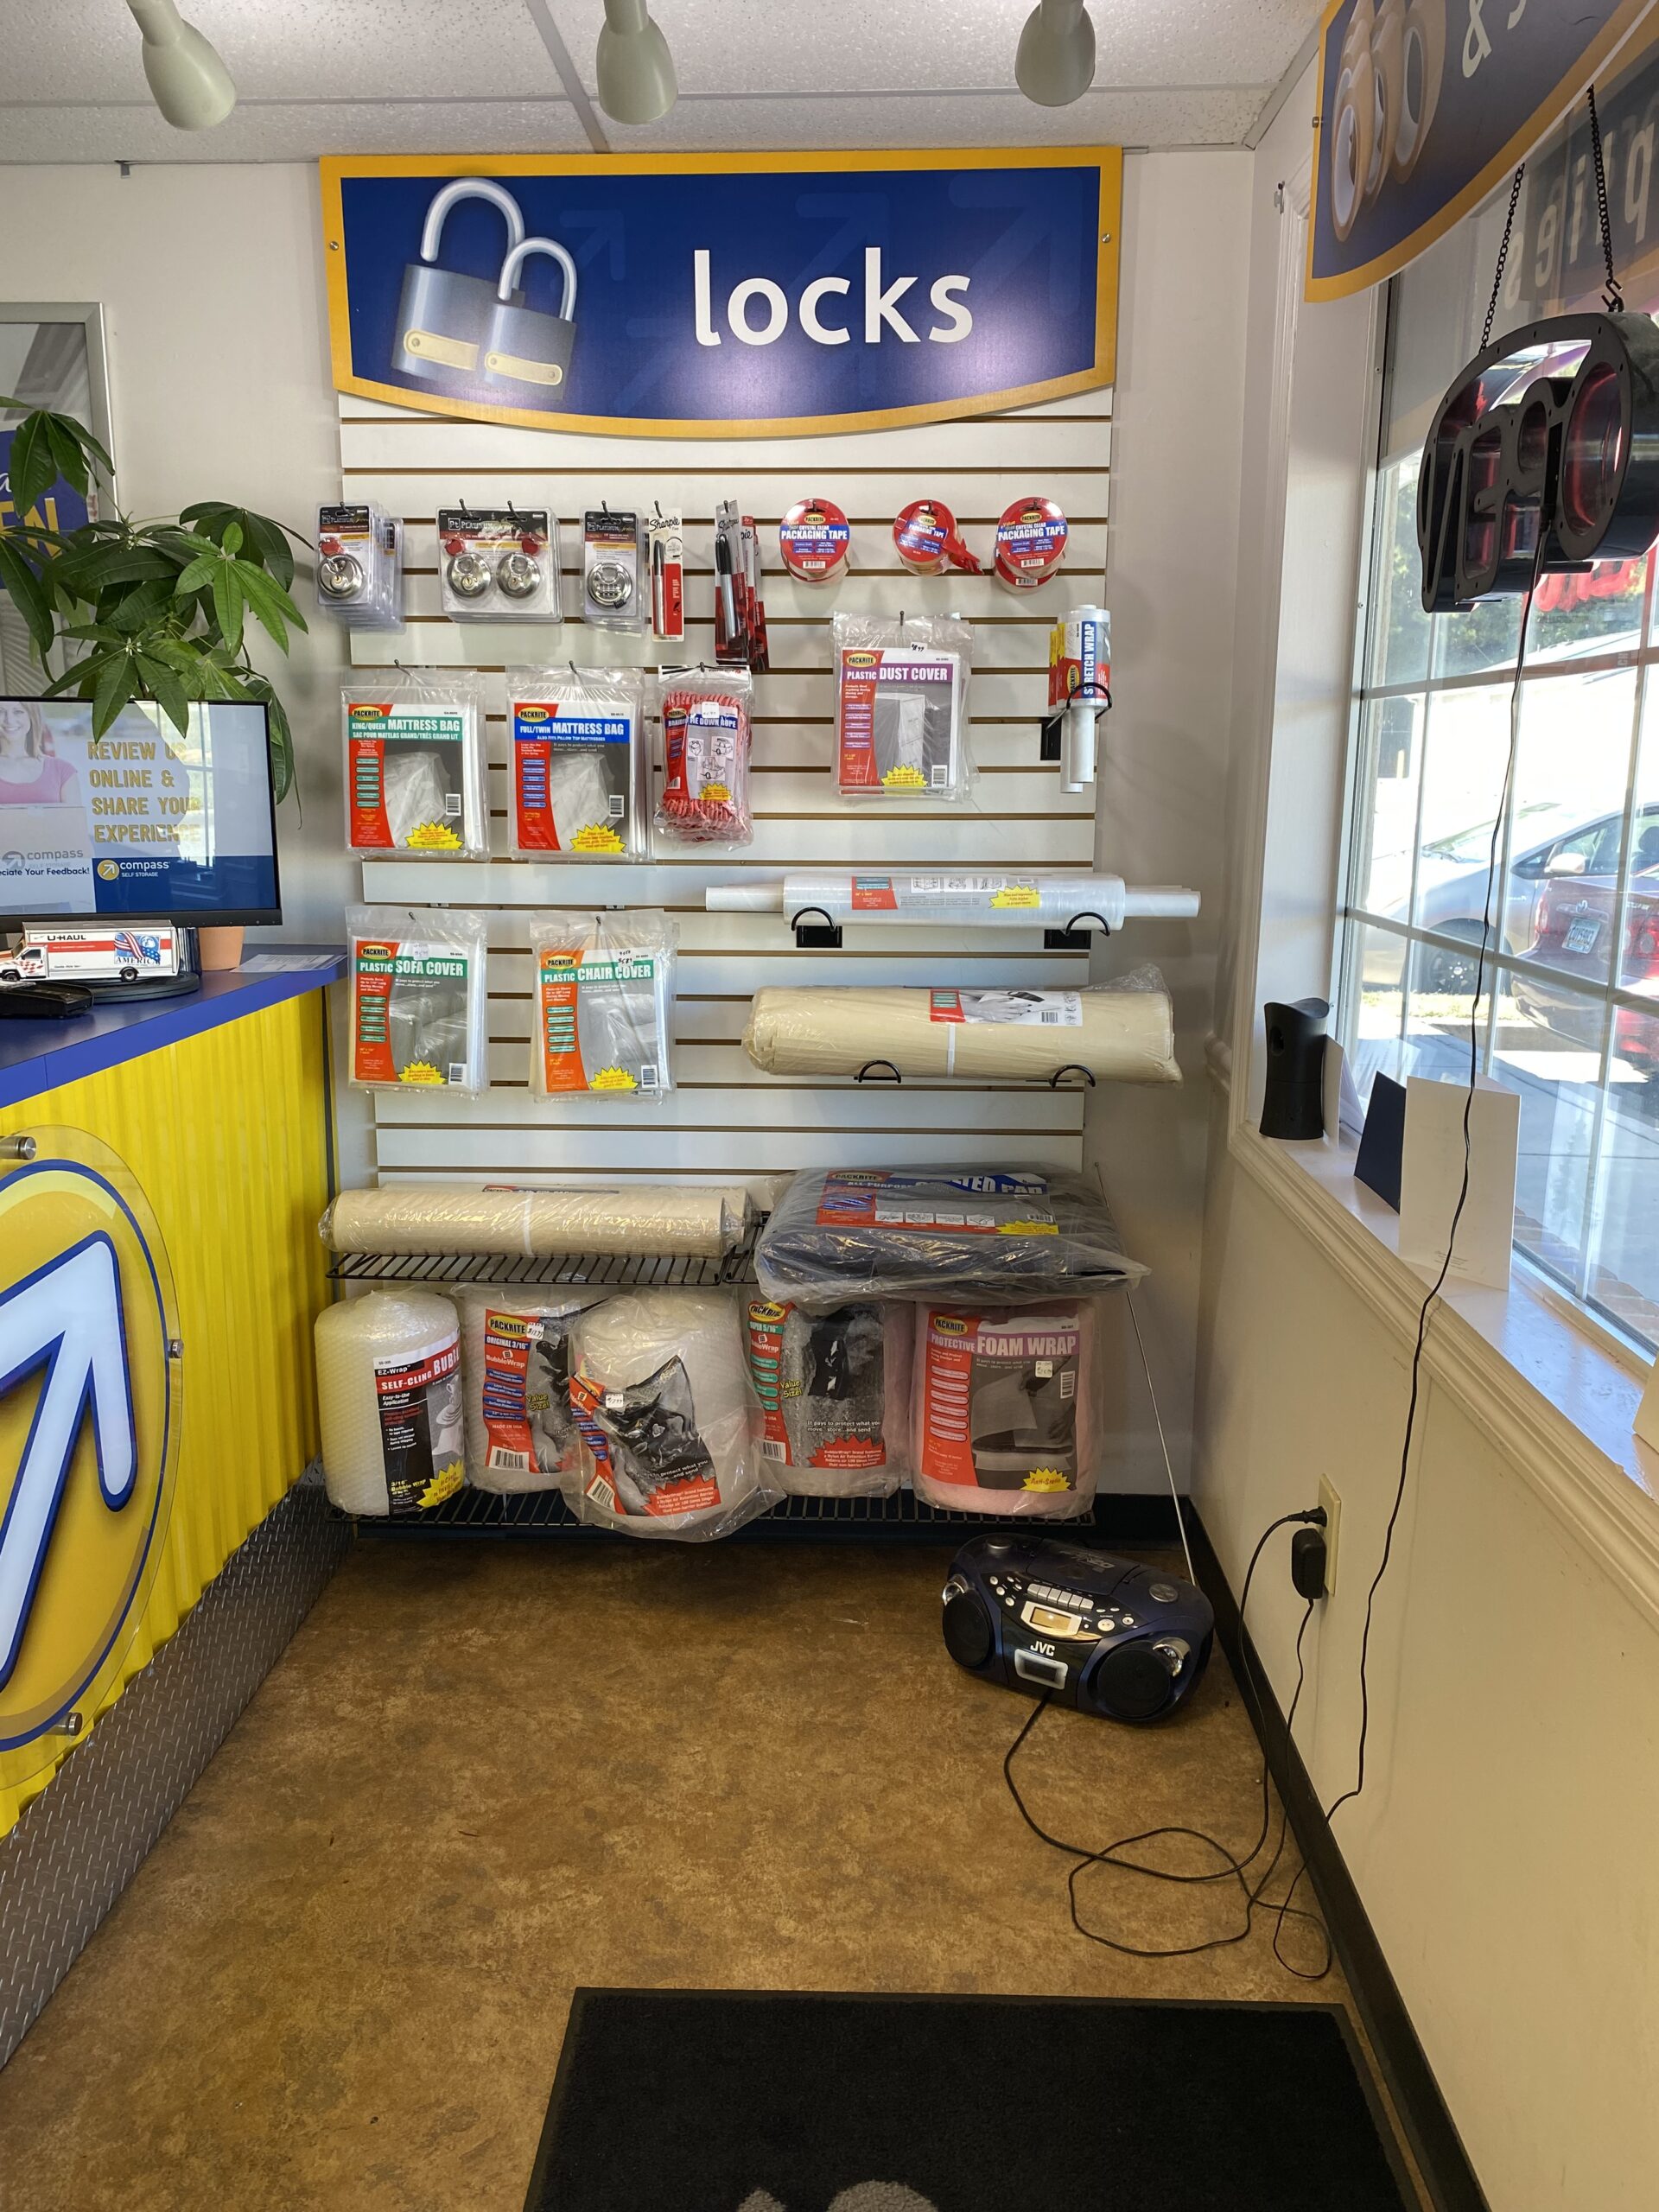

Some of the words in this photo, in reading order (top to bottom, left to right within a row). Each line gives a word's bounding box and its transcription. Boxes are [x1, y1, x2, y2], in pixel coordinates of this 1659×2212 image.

[695, 247, 973, 346] locks
[649, 516, 680, 531] Sharpie
[781, 530, 827, 540] PACKAGING
[828, 530, 847, 540] TAPE
[909, 524, 932, 535] PACKAGING
[933, 530, 944, 539] TAPE
[998, 527, 1044, 542] PACKAGING
[1046, 525, 1065, 536] TAPE
[1084, 623, 1095, 652] WRAP
[847, 671, 877, 680] PLASTIC
[880, 667, 909, 680] DUST
[911, 667, 948, 681] COVER
[1084, 653, 1095, 695] SRETCH
[388, 719, 437, 732] MATTRESS
[440, 720, 460, 732] BAG
[552, 722, 602, 734] MATTRESS
[604, 723, 624, 735] BAG
[721, 717, 736, 728] ROPE
[87, 741, 156, 760] REVIEW
[89, 769, 153, 788] ONLINE
[161, 769, 175, 787] &
[92, 797, 149, 815] SHARE
[157, 797, 200, 815] YOUR
[27, 850, 84, 861] compass
[0, 868, 22, 876] ciate
[46, 867, 90, 875] Feedback!
[119, 861, 169, 872] compass
[359, 962, 393, 973] PLASTIC
[395, 959, 424, 974] SOFA
[426, 961, 464, 976] COVER
[544, 973, 575, 982] PLASTIC
[577, 967, 613, 981] CHAIR
[615, 965, 651, 979] COVER
[1002, 1183, 1043, 1195] PAD
[750, 1305, 781, 1317] PACKRITE
[490, 1319, 525, 1334] PACKRITE
[935, 1318, 965, 1332] PACKRITE
[486, 1336, 511, 1348] ORIGINAL
[931, 1333, 975, 1352] PROTECTIVE
[977, 1336, 1024, 1357] FOAM
[1027, 1335, 1077, 1356] WRAP
[486, 1354, 525, 1368] BubbleWrap
[381, 1370, 432, 1390] SELF-CLING
[780, 1380, 800, 1389] Value
[383, 1392, 410, 1401] Easy-to-Use
[525, 1393, 548, 1402] Value
[783, 1389, 802, 1398] Size!
[529, 1401, 550, 1411] Size!
[660, 1468, 681, 1477] protect
[1030, 1641, 1055, 1656] JVC
